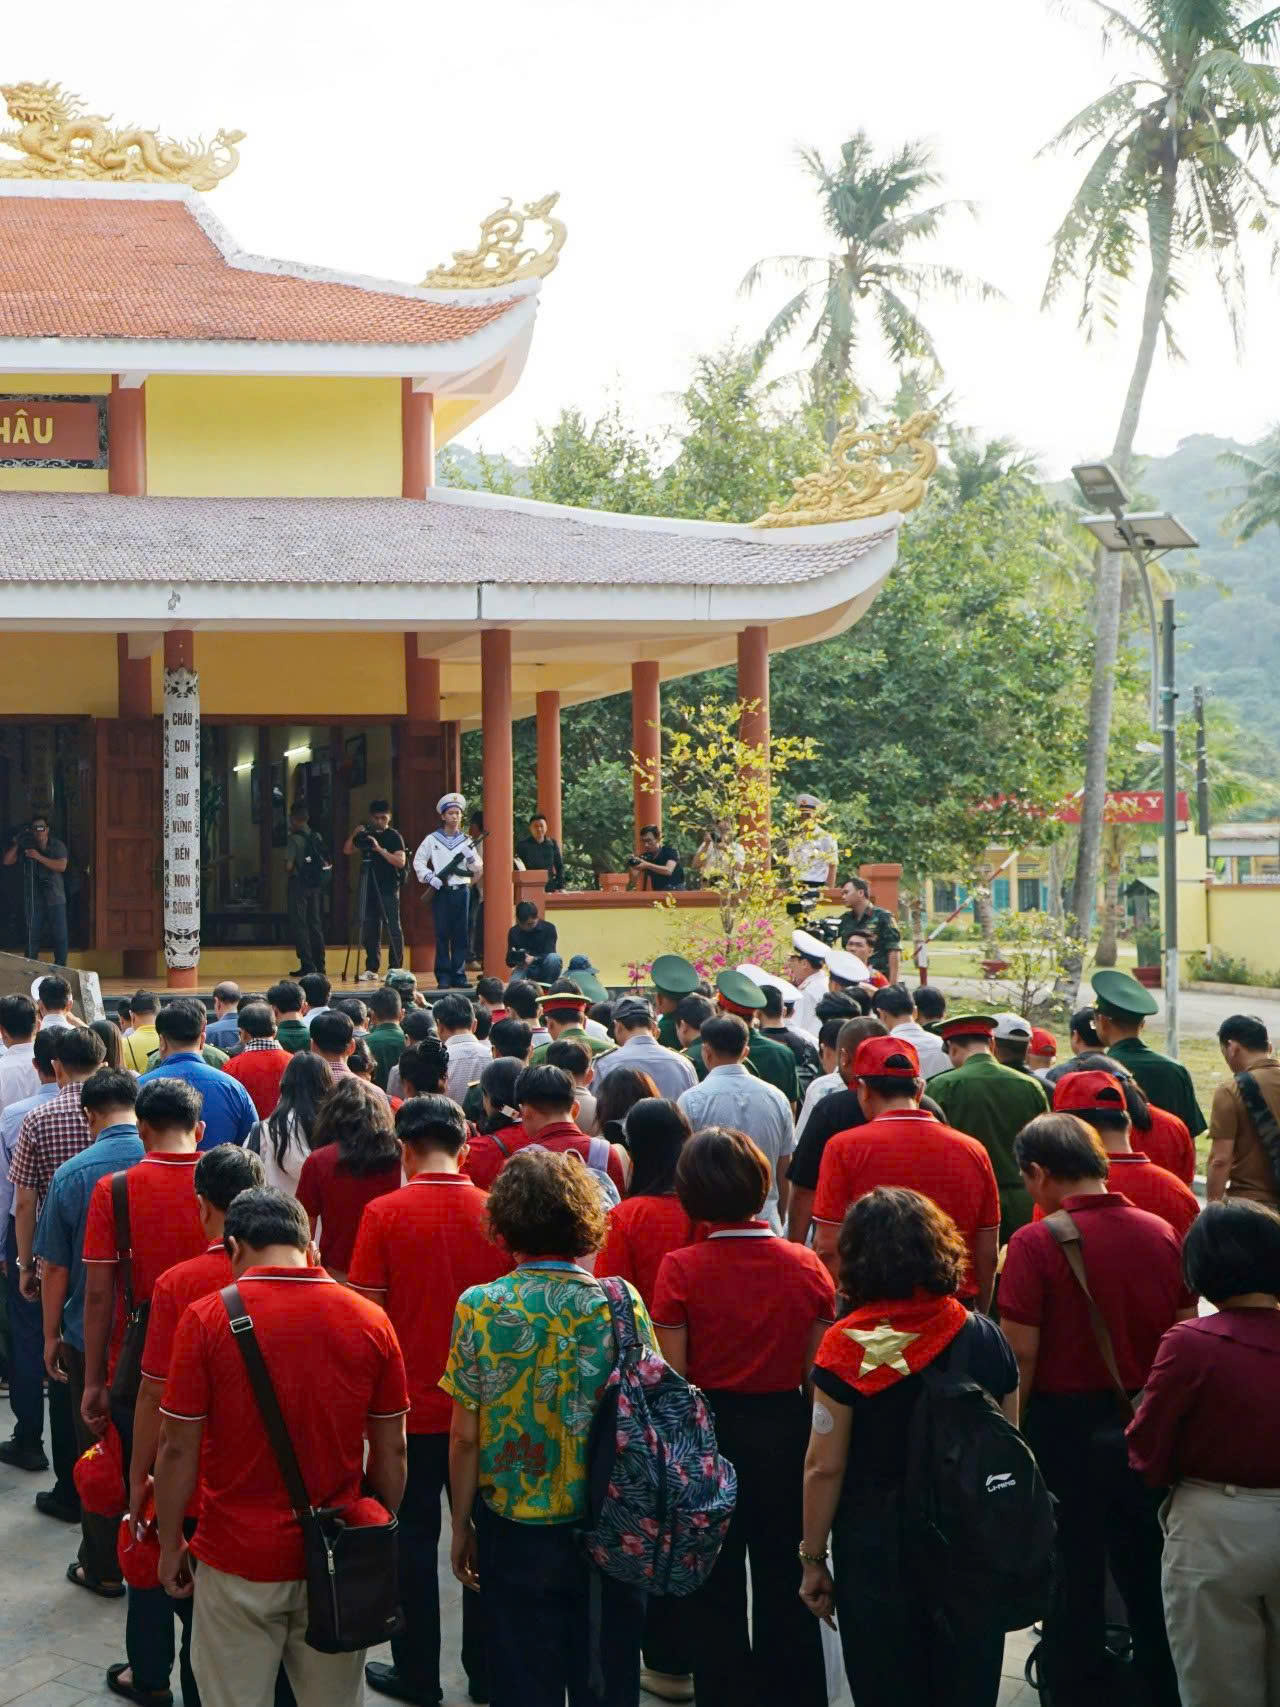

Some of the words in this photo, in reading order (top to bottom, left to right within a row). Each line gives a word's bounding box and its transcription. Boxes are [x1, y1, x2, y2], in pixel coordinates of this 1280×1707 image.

[172, 710, 193, 726] CHÁU
[174, 740, 191, 753] CON
[174, 874, 191, 888] NON
